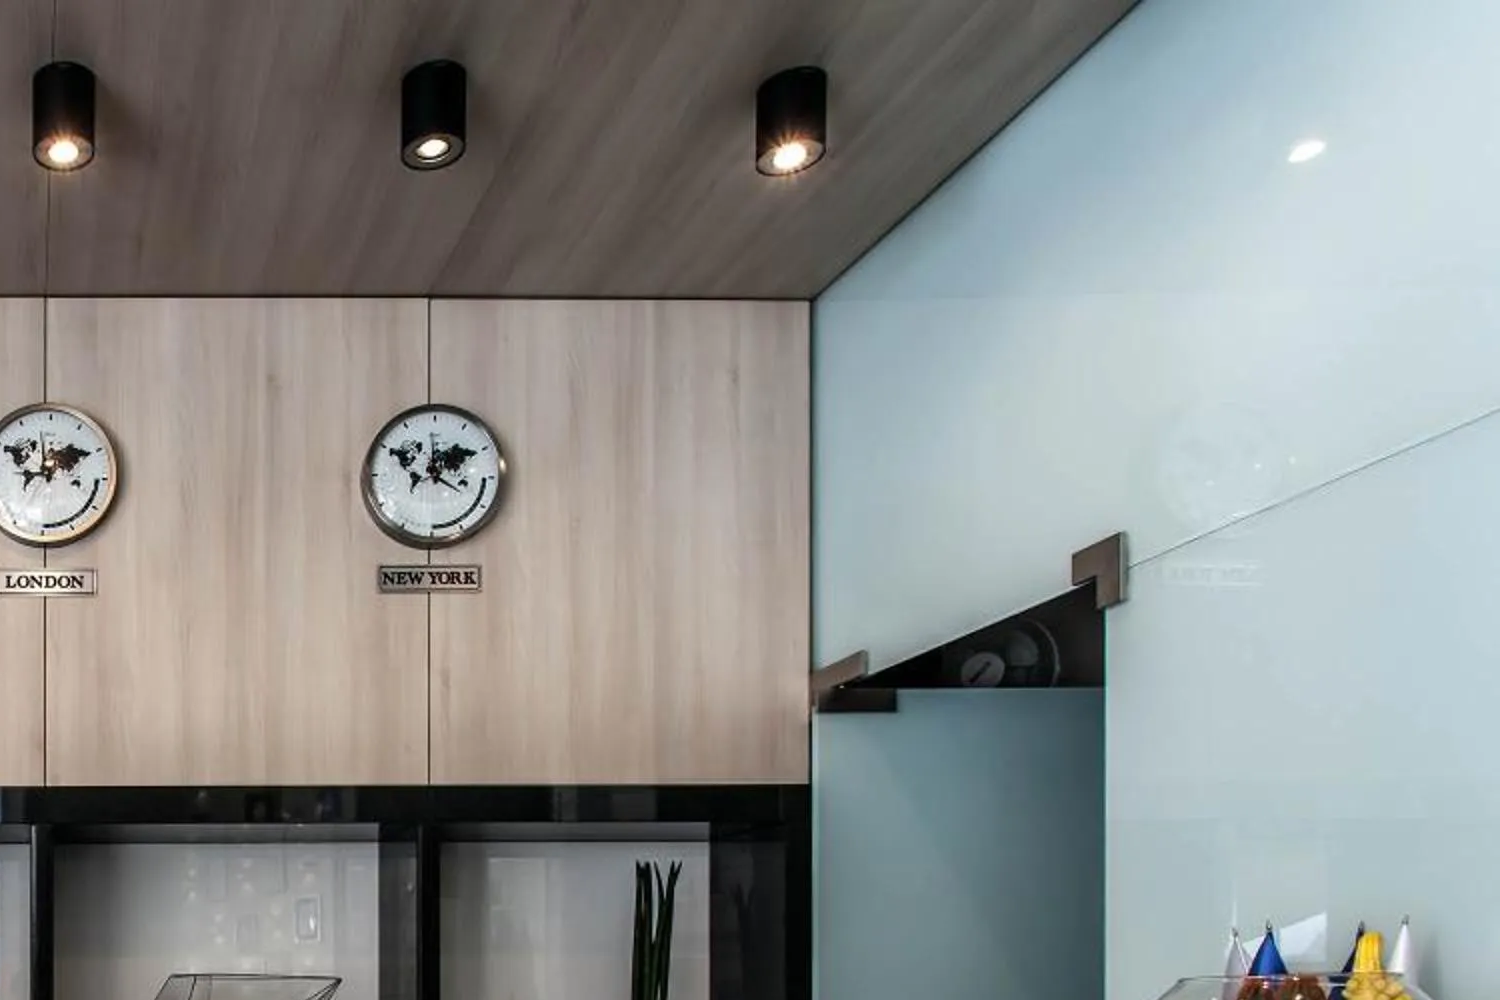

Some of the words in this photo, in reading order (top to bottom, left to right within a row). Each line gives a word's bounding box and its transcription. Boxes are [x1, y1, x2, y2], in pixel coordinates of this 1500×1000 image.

[5, 575, 85, 589] LONDON
[381, 572, 425, 585] NEW
[426, 571, 477, 585] YORK
